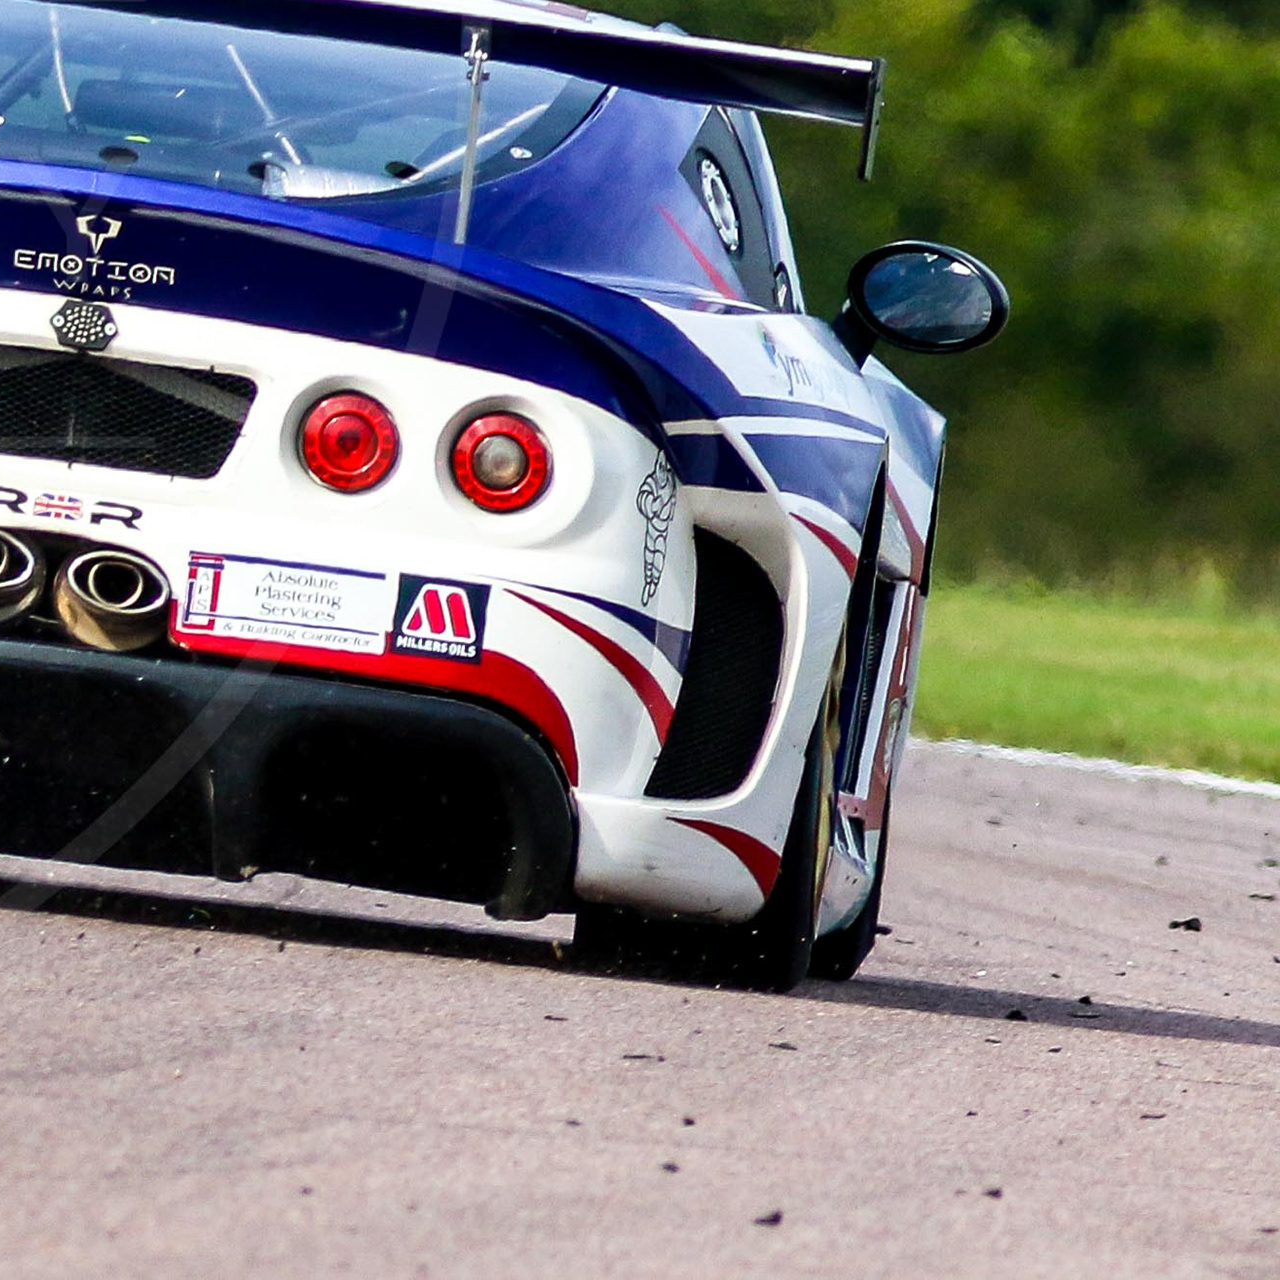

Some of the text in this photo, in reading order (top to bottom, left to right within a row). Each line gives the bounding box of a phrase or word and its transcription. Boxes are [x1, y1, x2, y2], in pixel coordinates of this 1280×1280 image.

[14, 249, 175, 285] EMOTION
[53, 275, 132, 299] WRAPS
[261, 570, 339, 591] Absolute
[255, 585, 342, 611] Plastering
[260, 602, 336, 623] Services
[396, 635, 477, 658] MILLERS OILS
